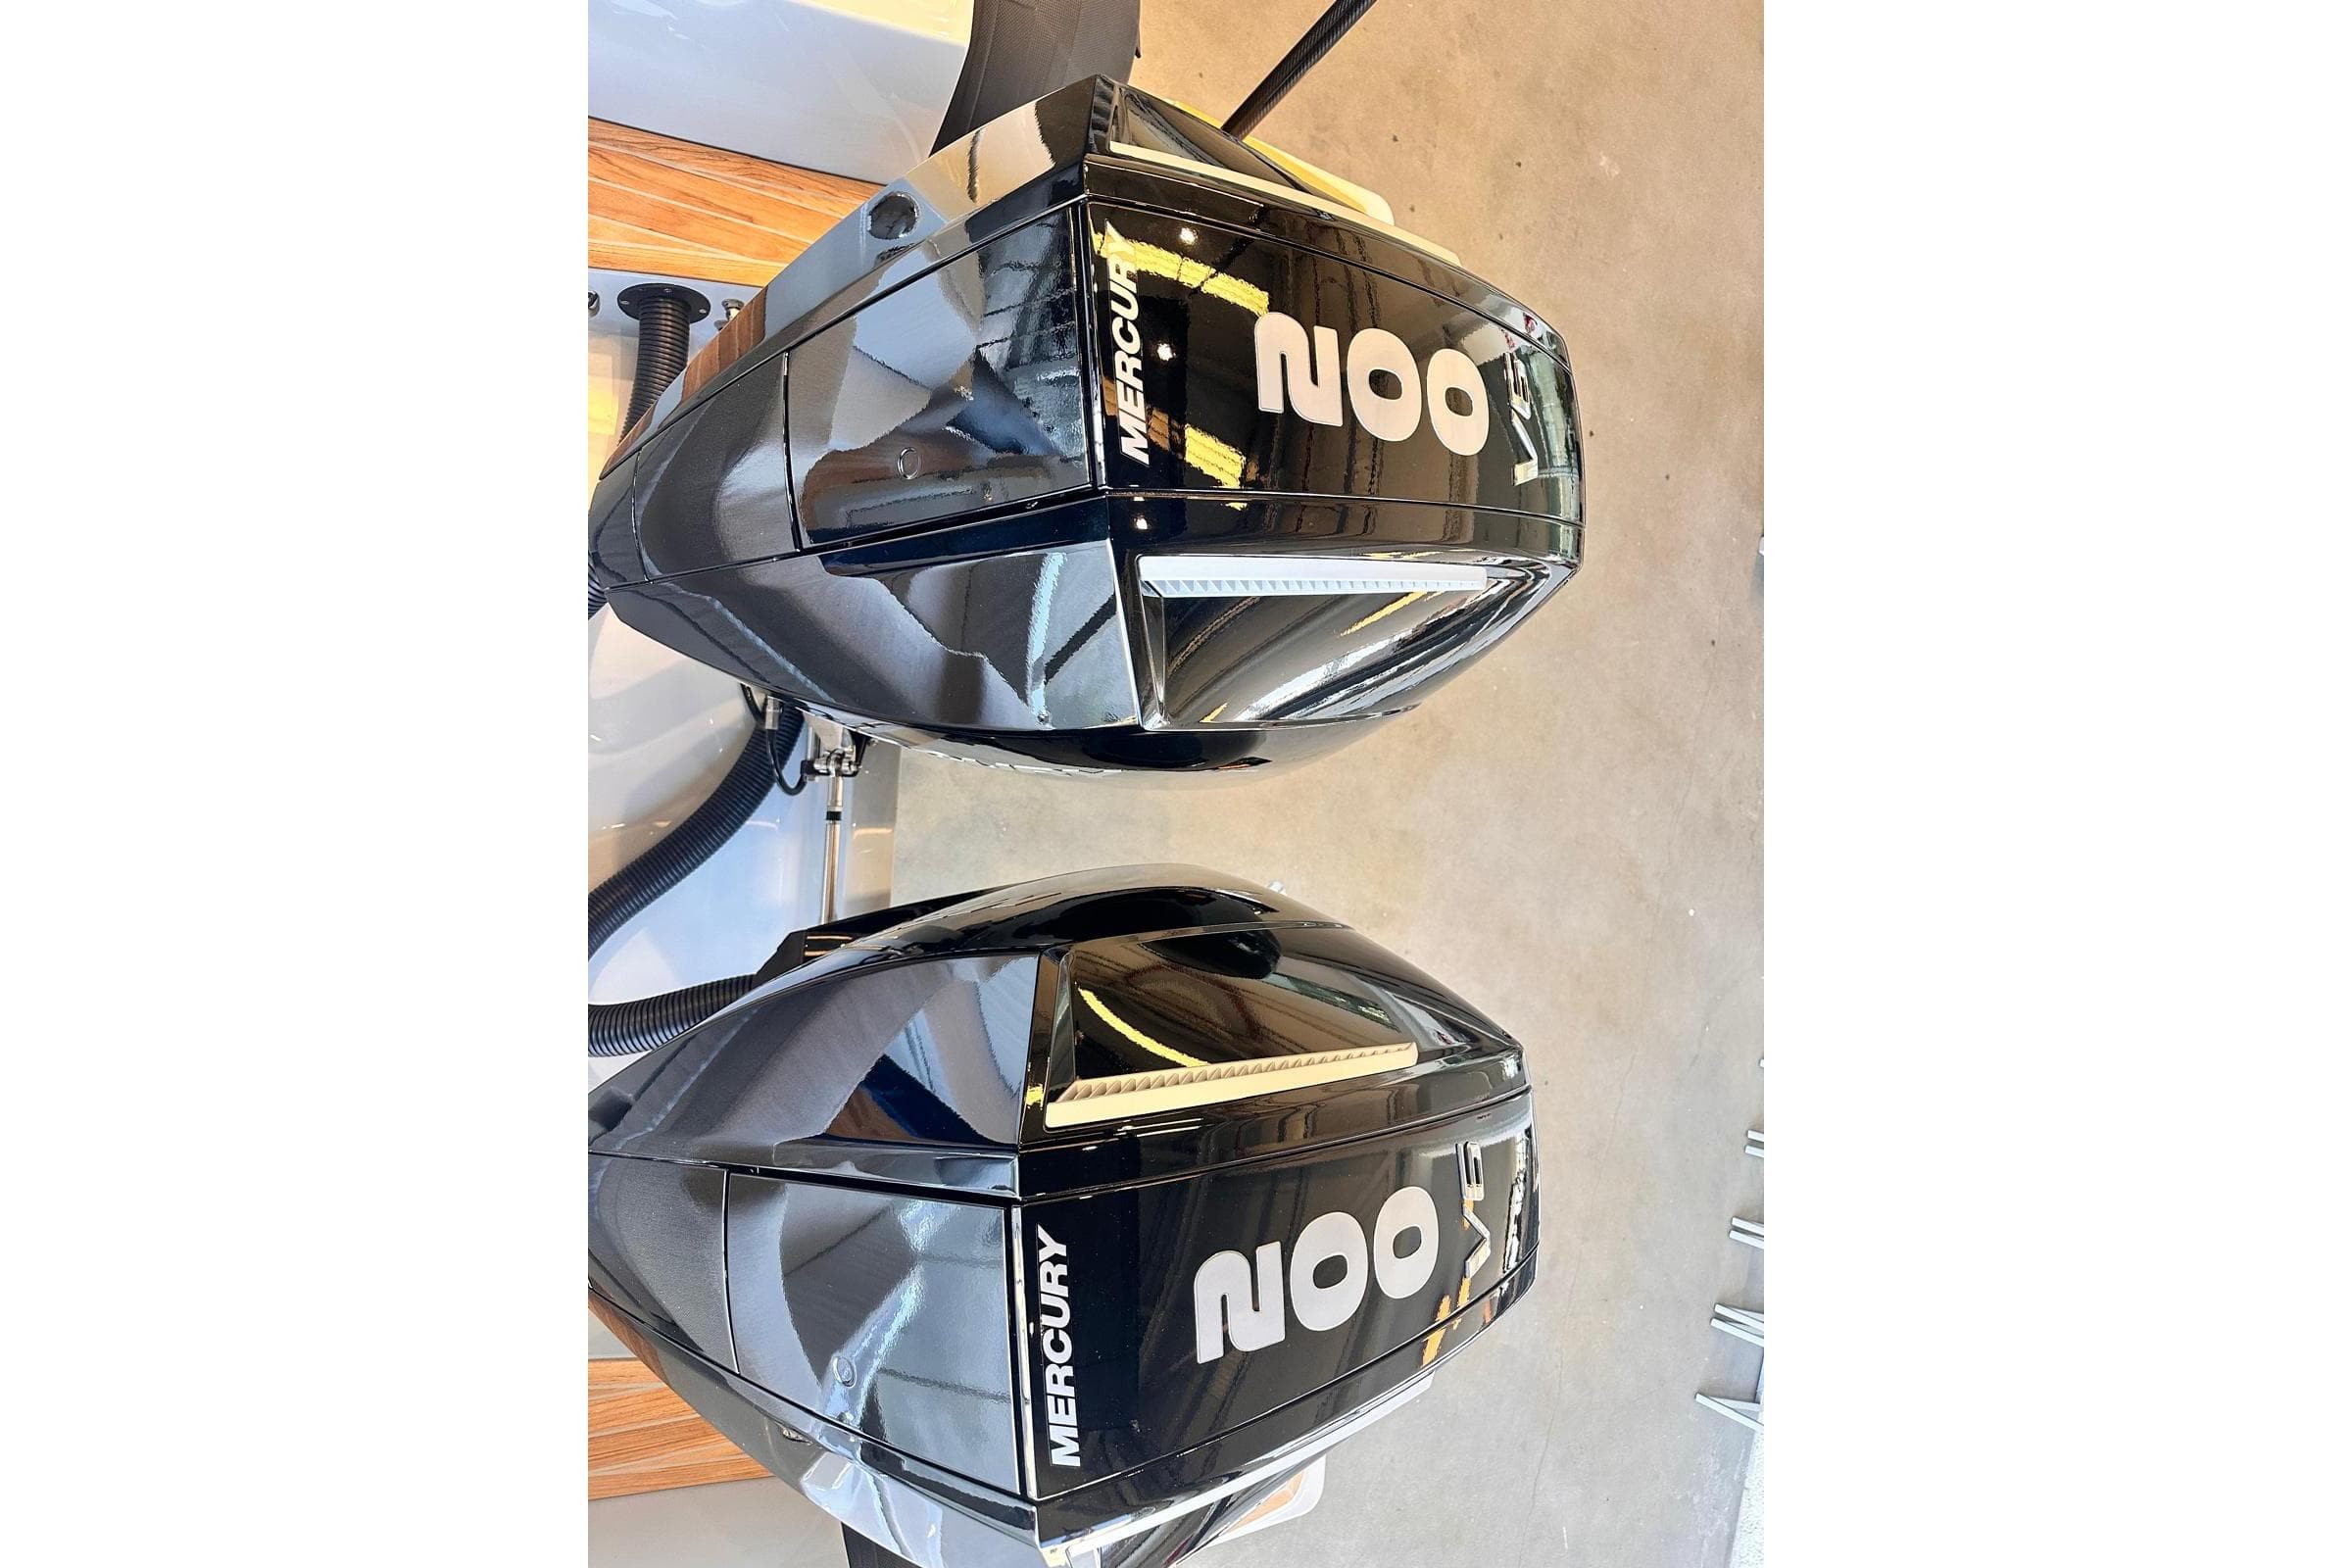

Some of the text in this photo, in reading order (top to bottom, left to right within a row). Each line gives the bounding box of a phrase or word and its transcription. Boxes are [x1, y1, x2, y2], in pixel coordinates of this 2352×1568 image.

[1105, 220, 1150, 467] MERCURY
[1253, 311, 1489, 457] 200
[1194, 1185, 1440, 1364] 200
[1456, 1140, 1492, 1279] V6
[1036, 1224, 1081, 1467] MERCURY
